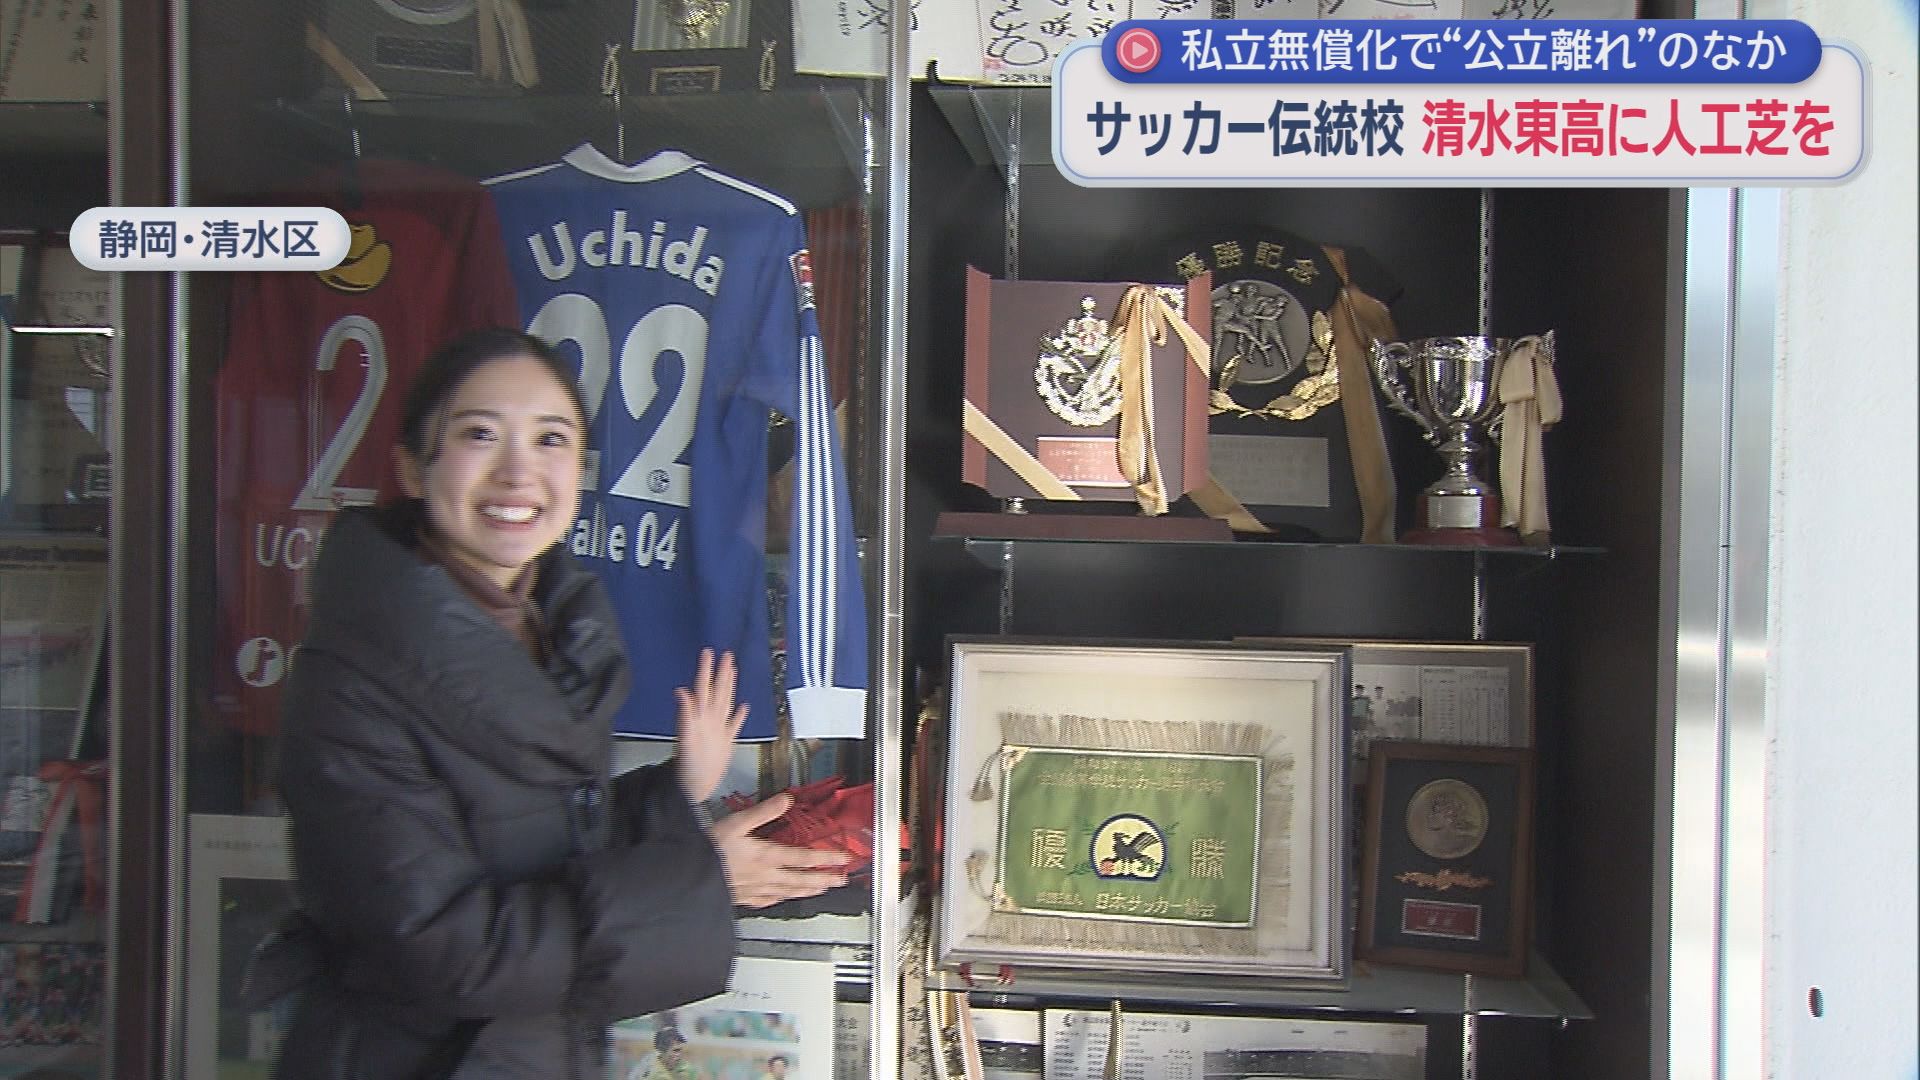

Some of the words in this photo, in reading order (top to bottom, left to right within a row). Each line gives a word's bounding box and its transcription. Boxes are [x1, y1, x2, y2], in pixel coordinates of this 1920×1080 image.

[527, 209, 726, 297] Uchida
[290, 315, 389, 512] 2
[635, 510, 680, 571] 04
[1031, 828, 1066, 869] 優
